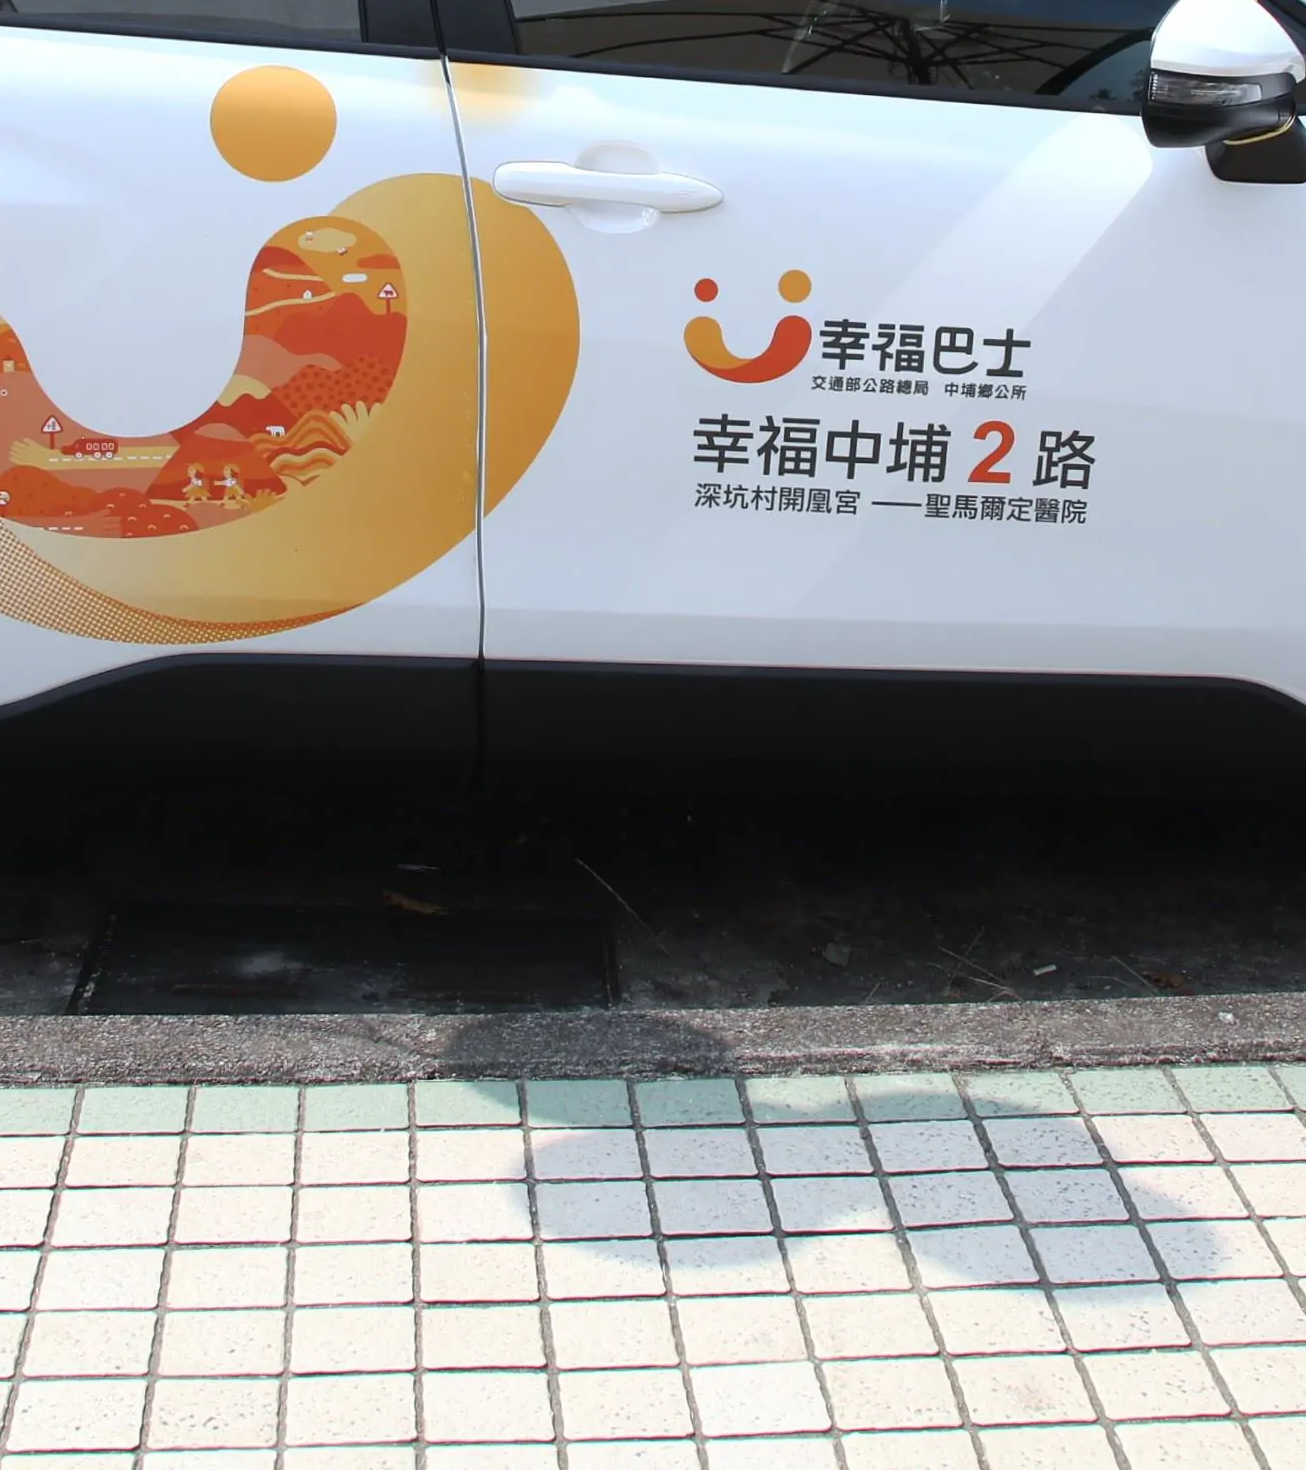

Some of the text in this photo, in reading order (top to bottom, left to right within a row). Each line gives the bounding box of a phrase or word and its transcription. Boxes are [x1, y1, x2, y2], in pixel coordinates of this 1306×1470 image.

[819, 318, 1032, 378] 幸福巴士
[811, 374, 1027, 401] 交通部公路總局 中埔鄉公所
